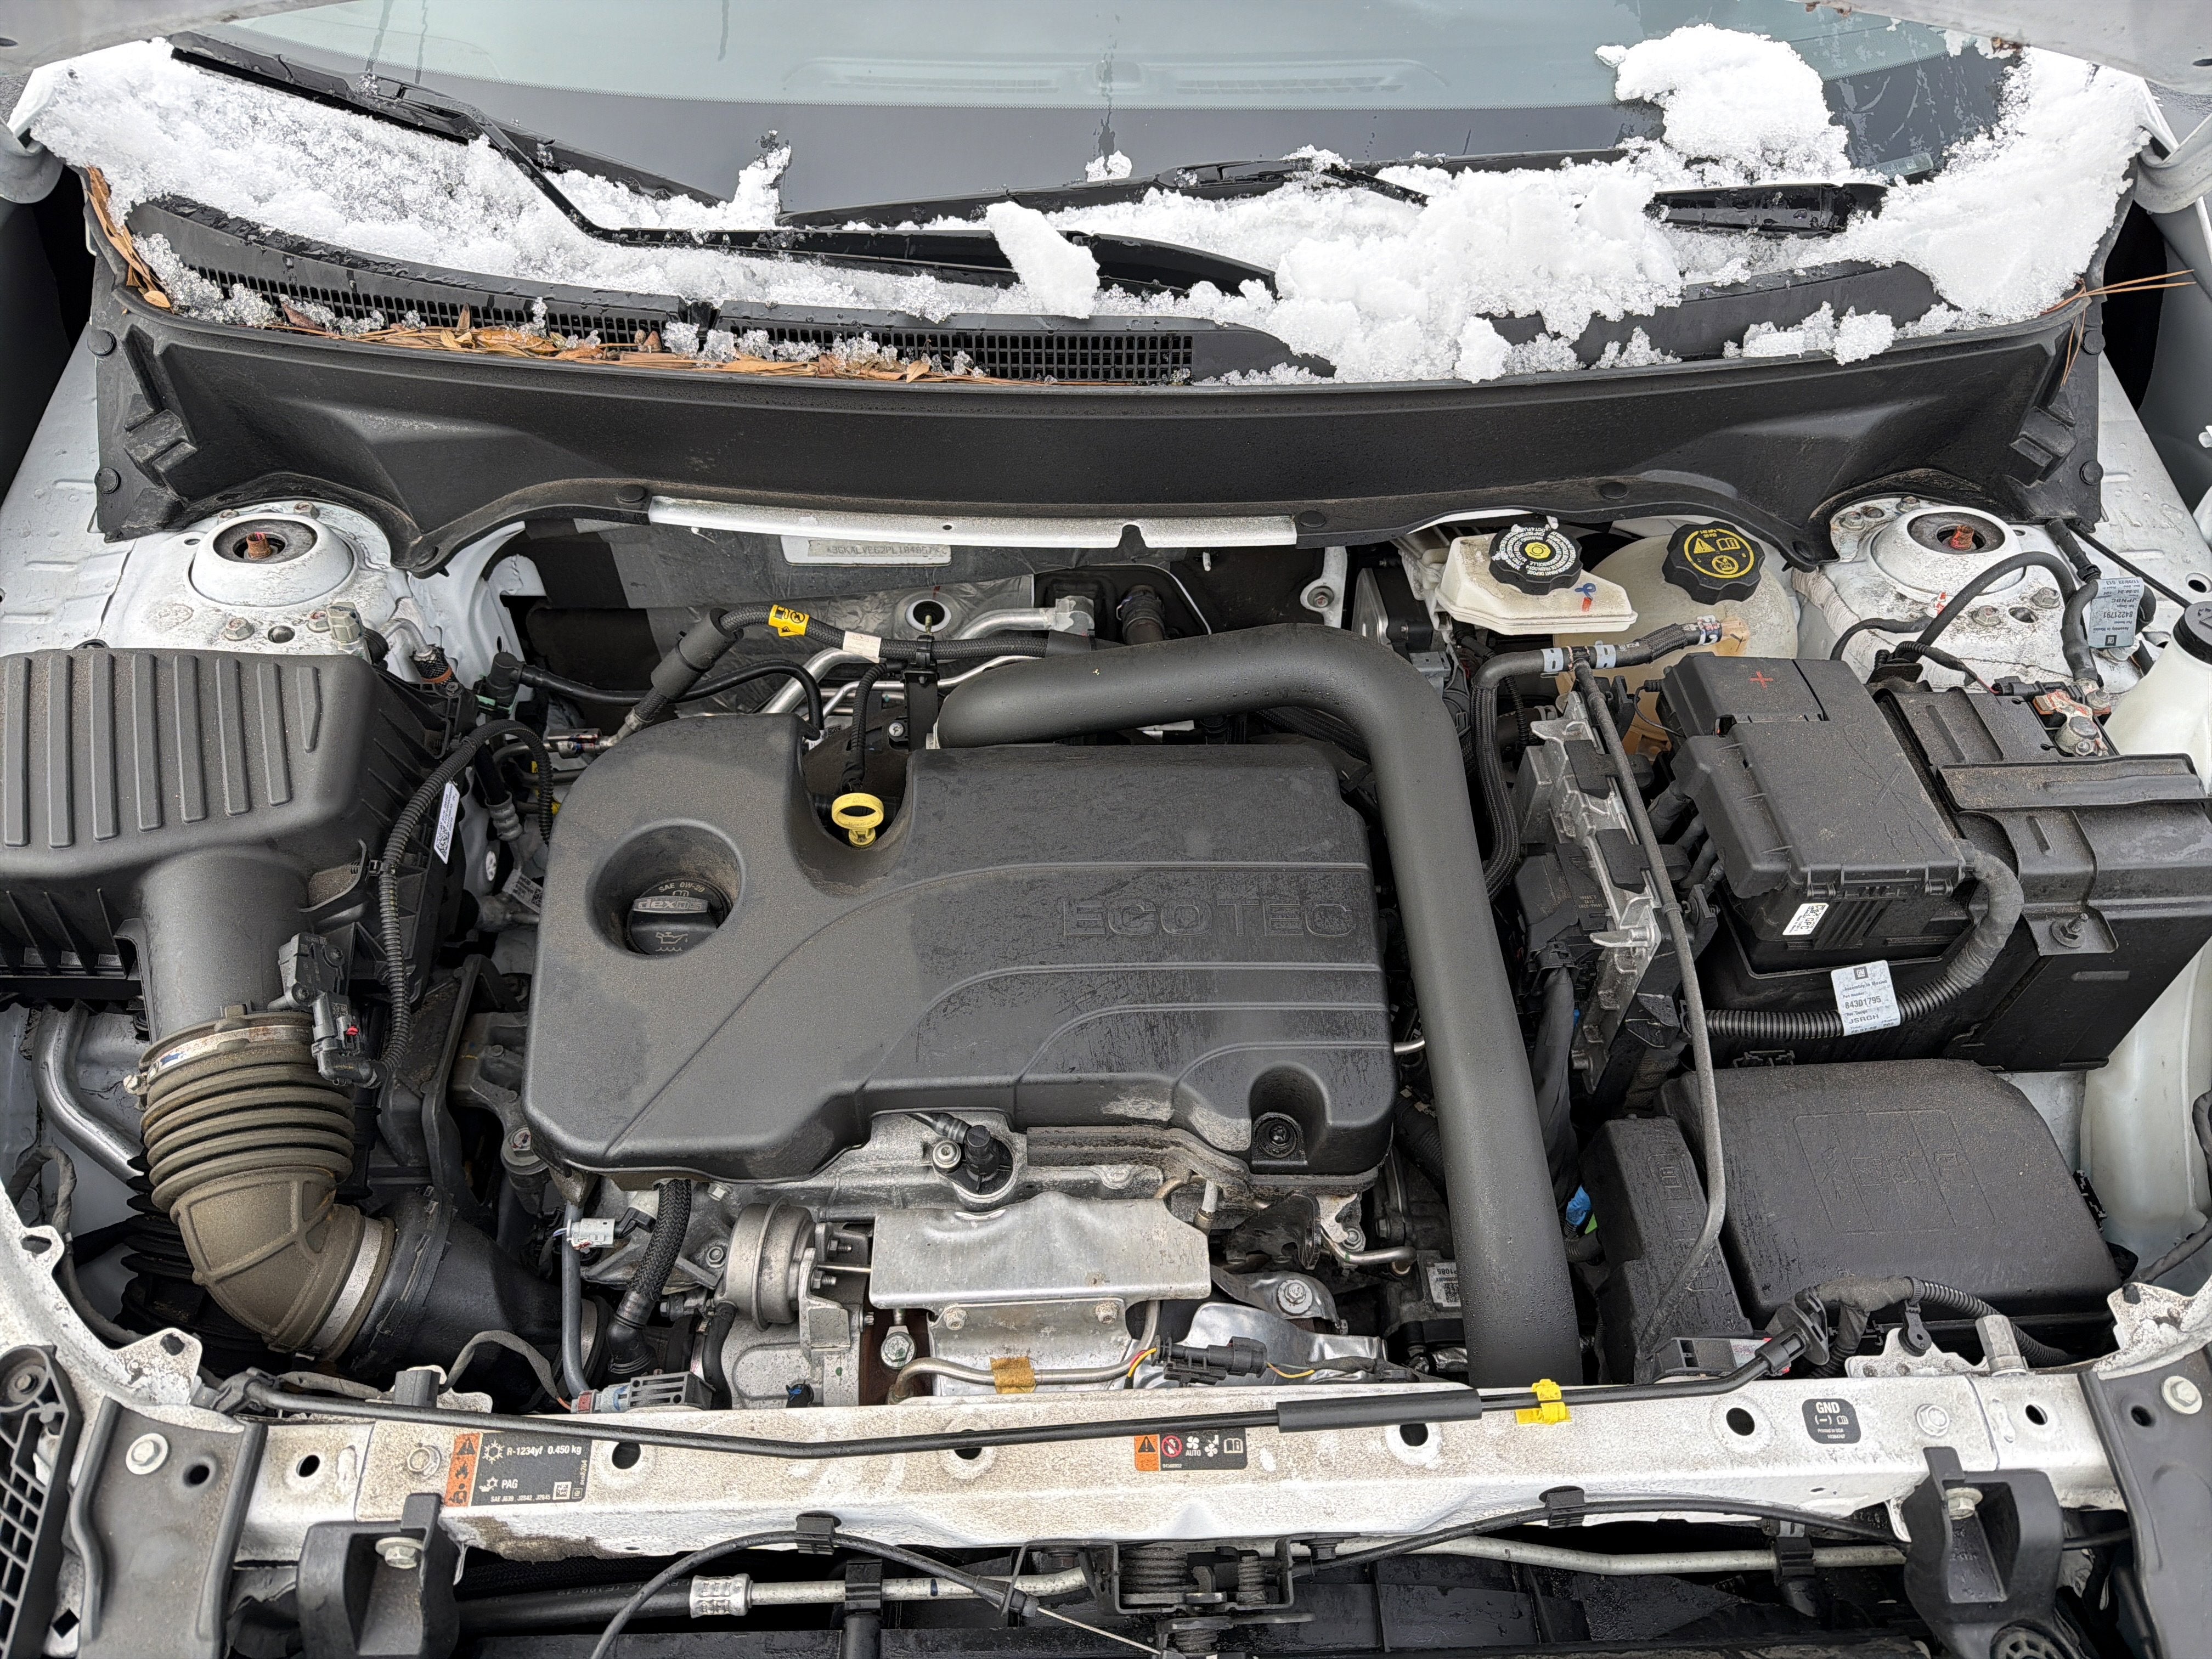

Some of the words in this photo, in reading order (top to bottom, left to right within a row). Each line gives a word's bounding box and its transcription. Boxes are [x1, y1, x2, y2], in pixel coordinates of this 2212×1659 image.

[658, 883, 675, 893] SAE
[679, 882, 706, 893] 0W-20
[637, 899, 703, 911] dexos
[1063, 900, 1356, 938] ECOTEC
[1800, 917, 1814, 929] GPC
[1815, 1402, 1840, 1414] GND
[507, 1446, 543, 1457] R-1234yf
[548, 1445, 570, 1455] 0.450
[572, 1444, 582, 1455] kg
[501, 1479, 518, 1489] PAG
